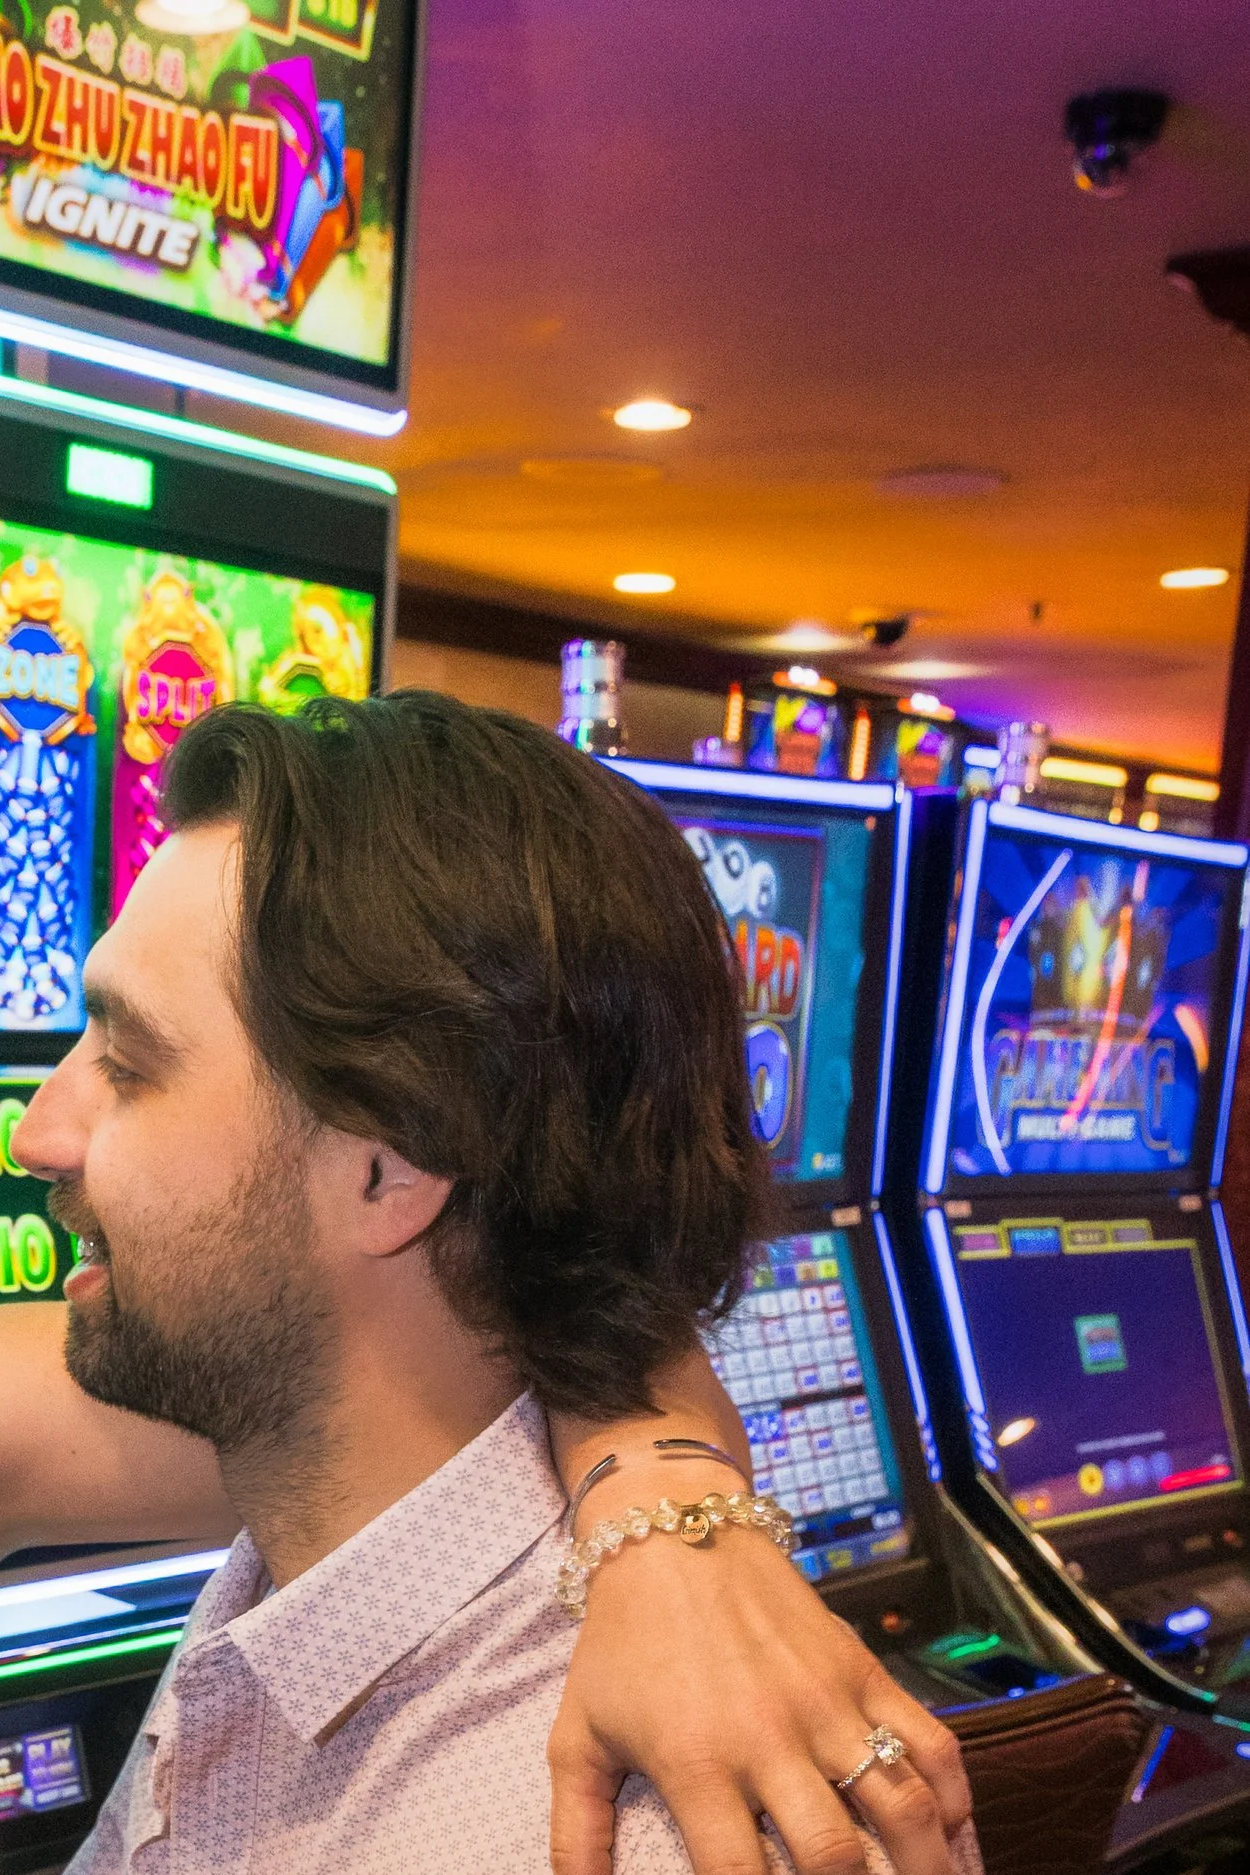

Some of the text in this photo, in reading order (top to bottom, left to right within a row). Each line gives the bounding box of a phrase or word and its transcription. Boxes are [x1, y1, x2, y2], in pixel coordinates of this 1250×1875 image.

[33, 53, 121, 171] ZHU
[119, 88, 228, 209] ZHAO
[226, 113, 279, 229] FU
[26, 178, 198, 266] IGNITE
[137, 671, 218, 728] SPLIT
